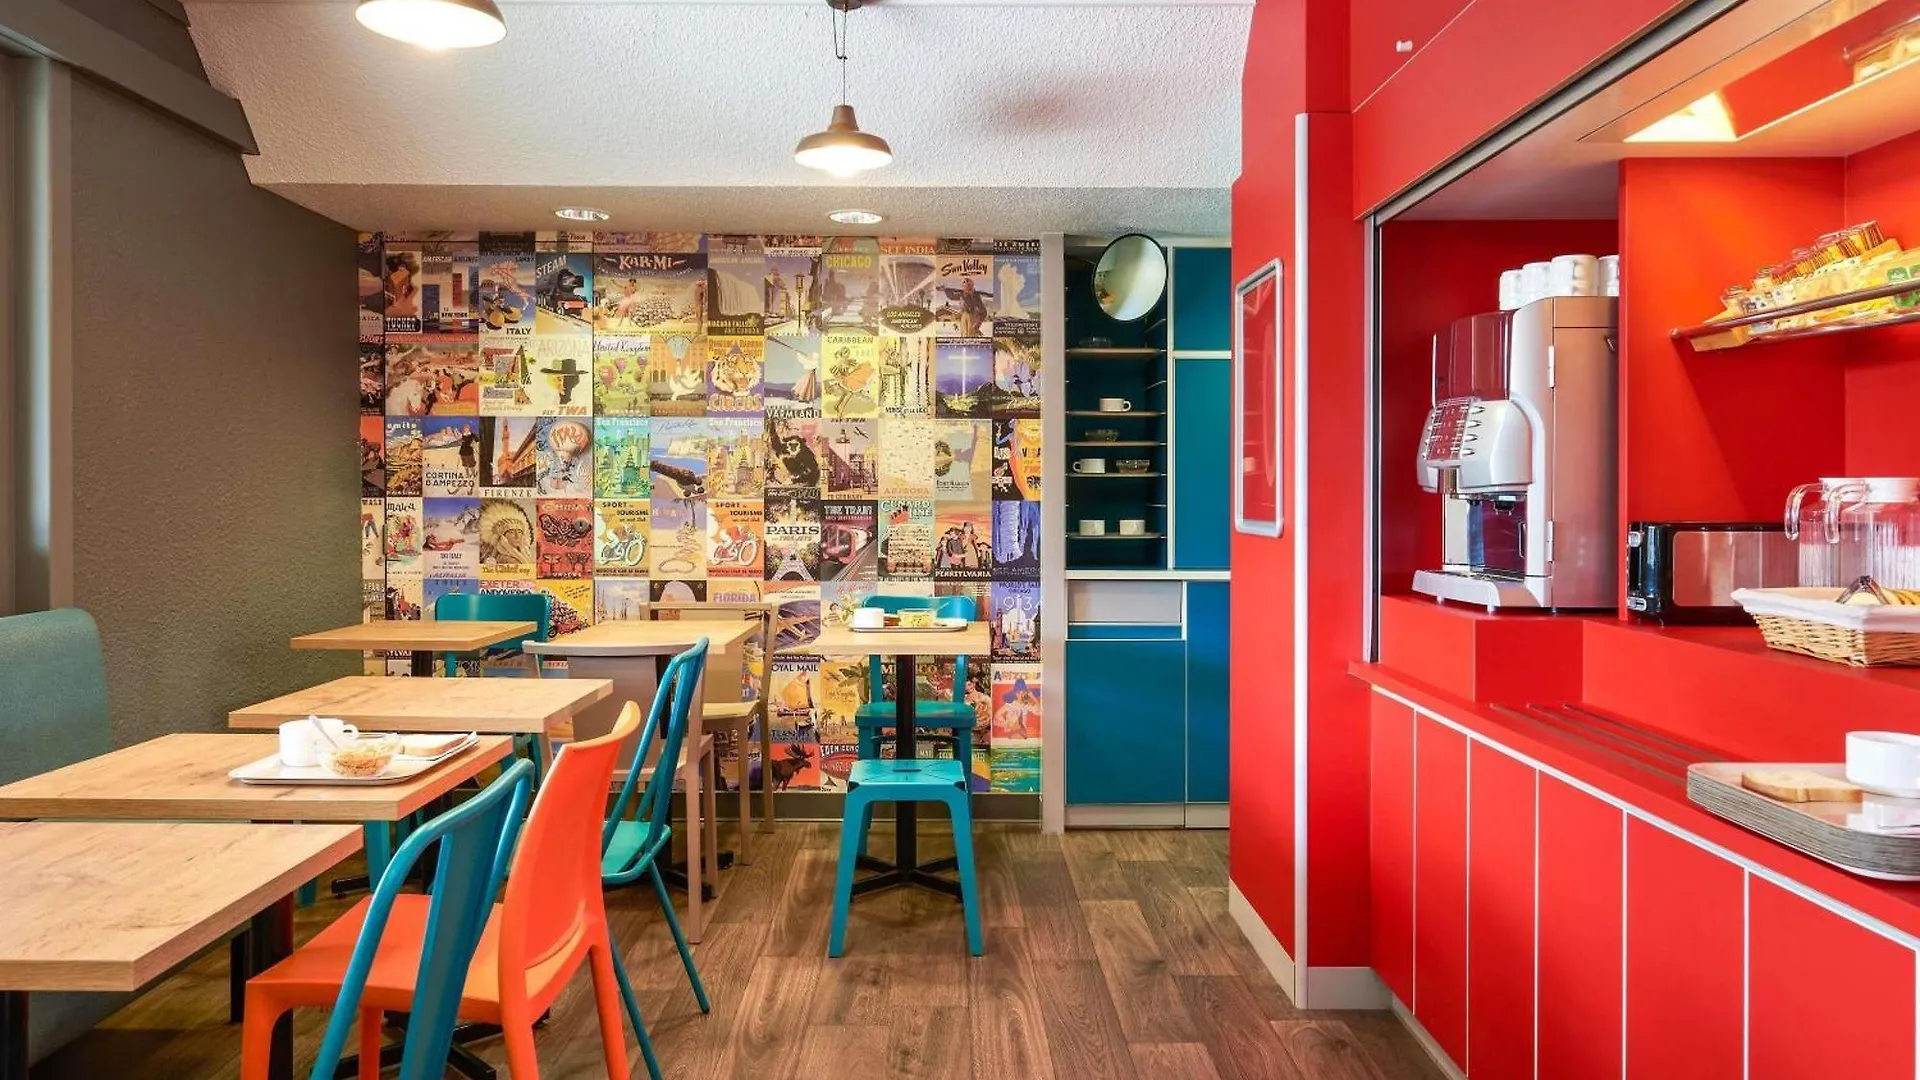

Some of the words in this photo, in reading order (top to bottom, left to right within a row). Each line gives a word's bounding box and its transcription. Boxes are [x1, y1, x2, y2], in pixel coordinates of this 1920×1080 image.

[904, 245, 936, 255] INDIA
[536, 255, 567, 279] STEAM
[618, 255, 672, 270] KAR-MI
[825, 255, 872, 269] CHICAGO
[940, 263, 962, 277] Sun
[962, 258, 988, 275] Valley
[506, 327, 532, 335] ITALY
[827, 336, 874, 344] CARIBBEAN
[558, 406, 588, 416] TWA
[425, 472, 463, 480] CORTINA
[484, 489, 532, 498] FIRENZE
[823, 505, 843, 515] THE
[881, 500, 931, 512] CUNARD
[765, 526, 820, 535] PARIS
[935, 570, 991, 578] PENNSYLVANIA
[480, 580, 520, 588] EXETER
[714, 592, 756, 603] FLORIDA
[771, 663, 794, 672] OYAL
[797, 663, 819, 672] MAIL
